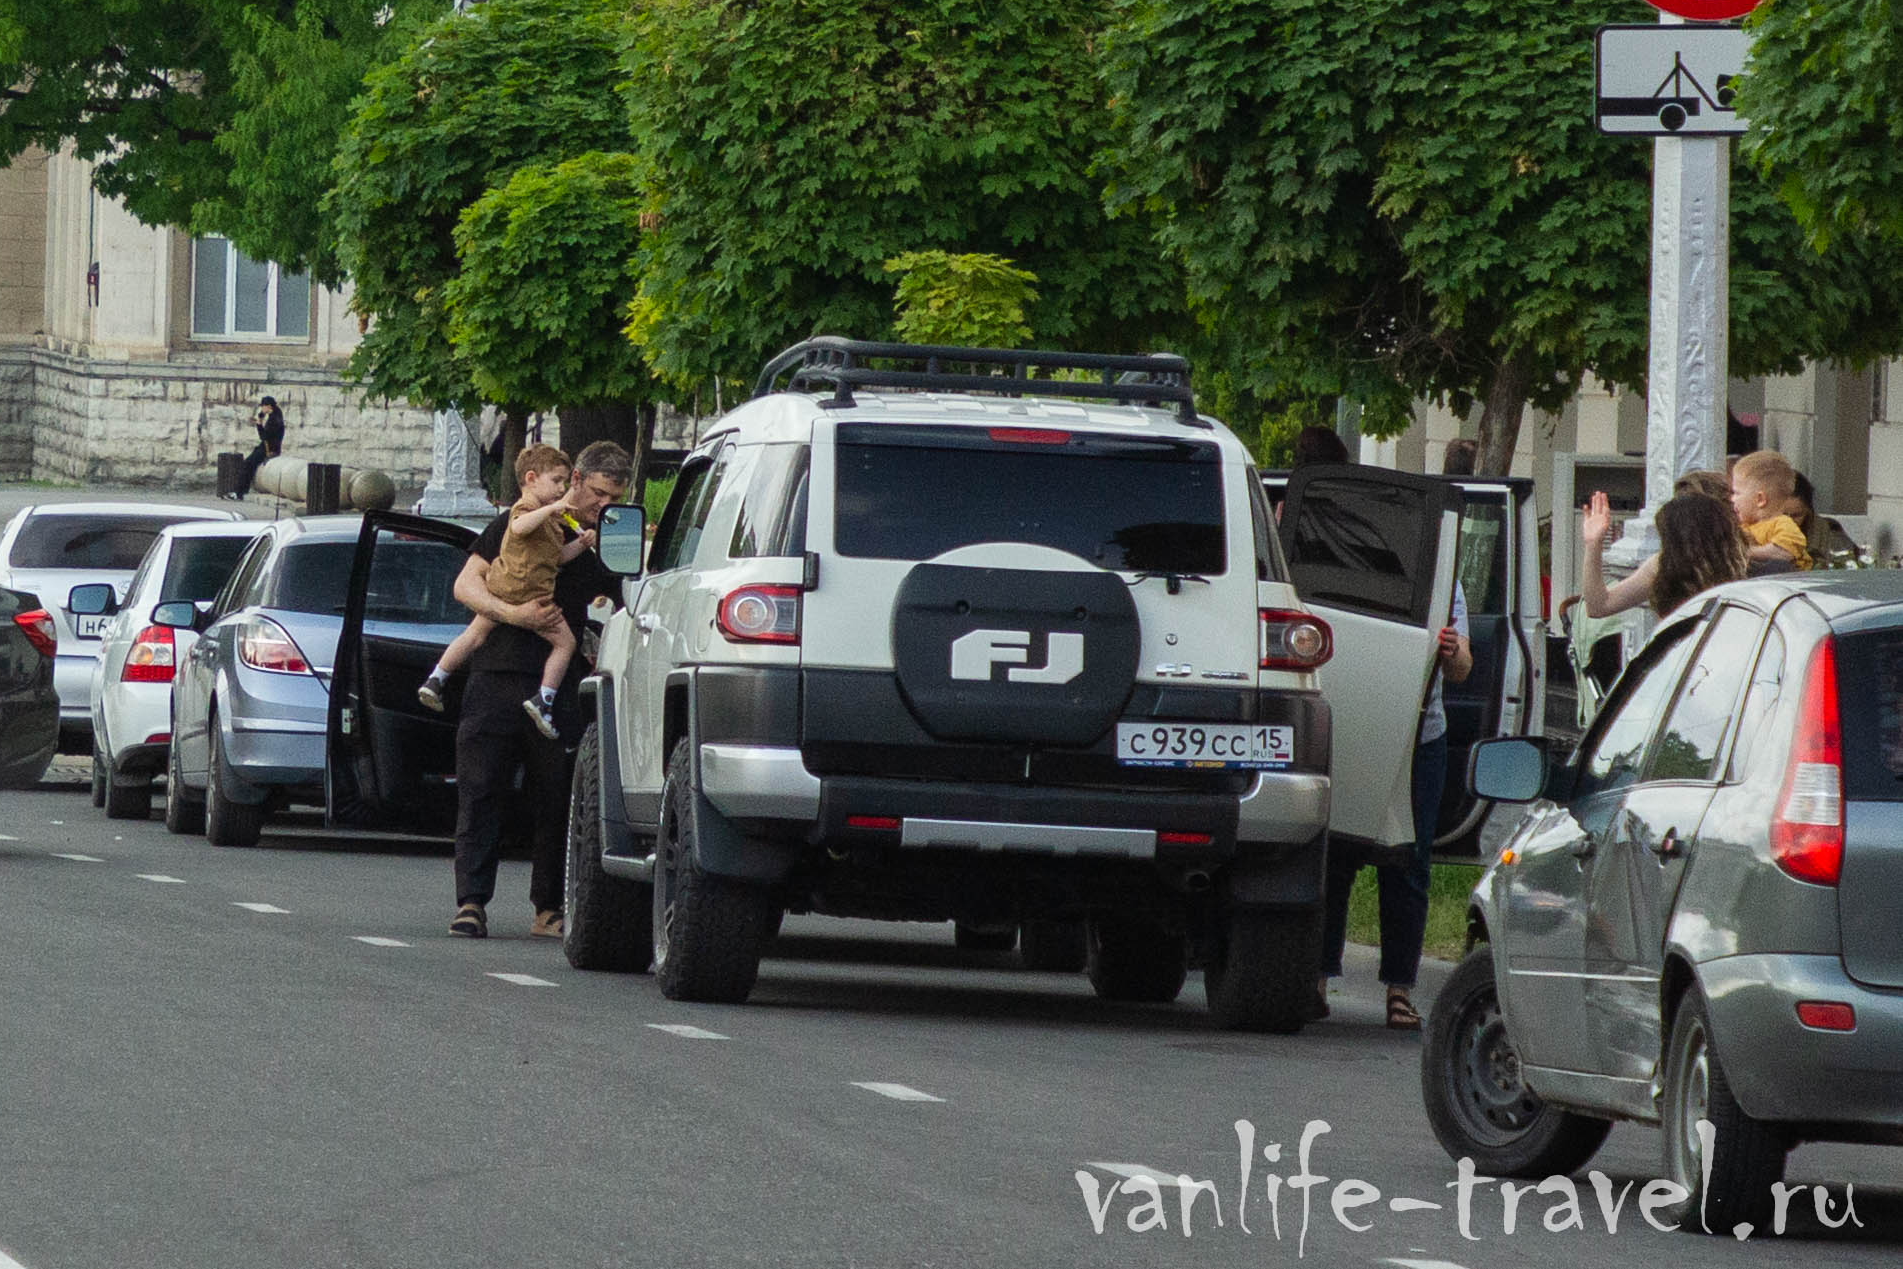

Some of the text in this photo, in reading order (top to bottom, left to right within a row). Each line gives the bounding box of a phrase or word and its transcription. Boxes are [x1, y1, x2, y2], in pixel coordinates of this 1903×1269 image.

[952, 629, 1084, 685] FJ
[1130, 727, 1282, 757] С939СС 15
[1253, 749, 1274, 758] RUS
